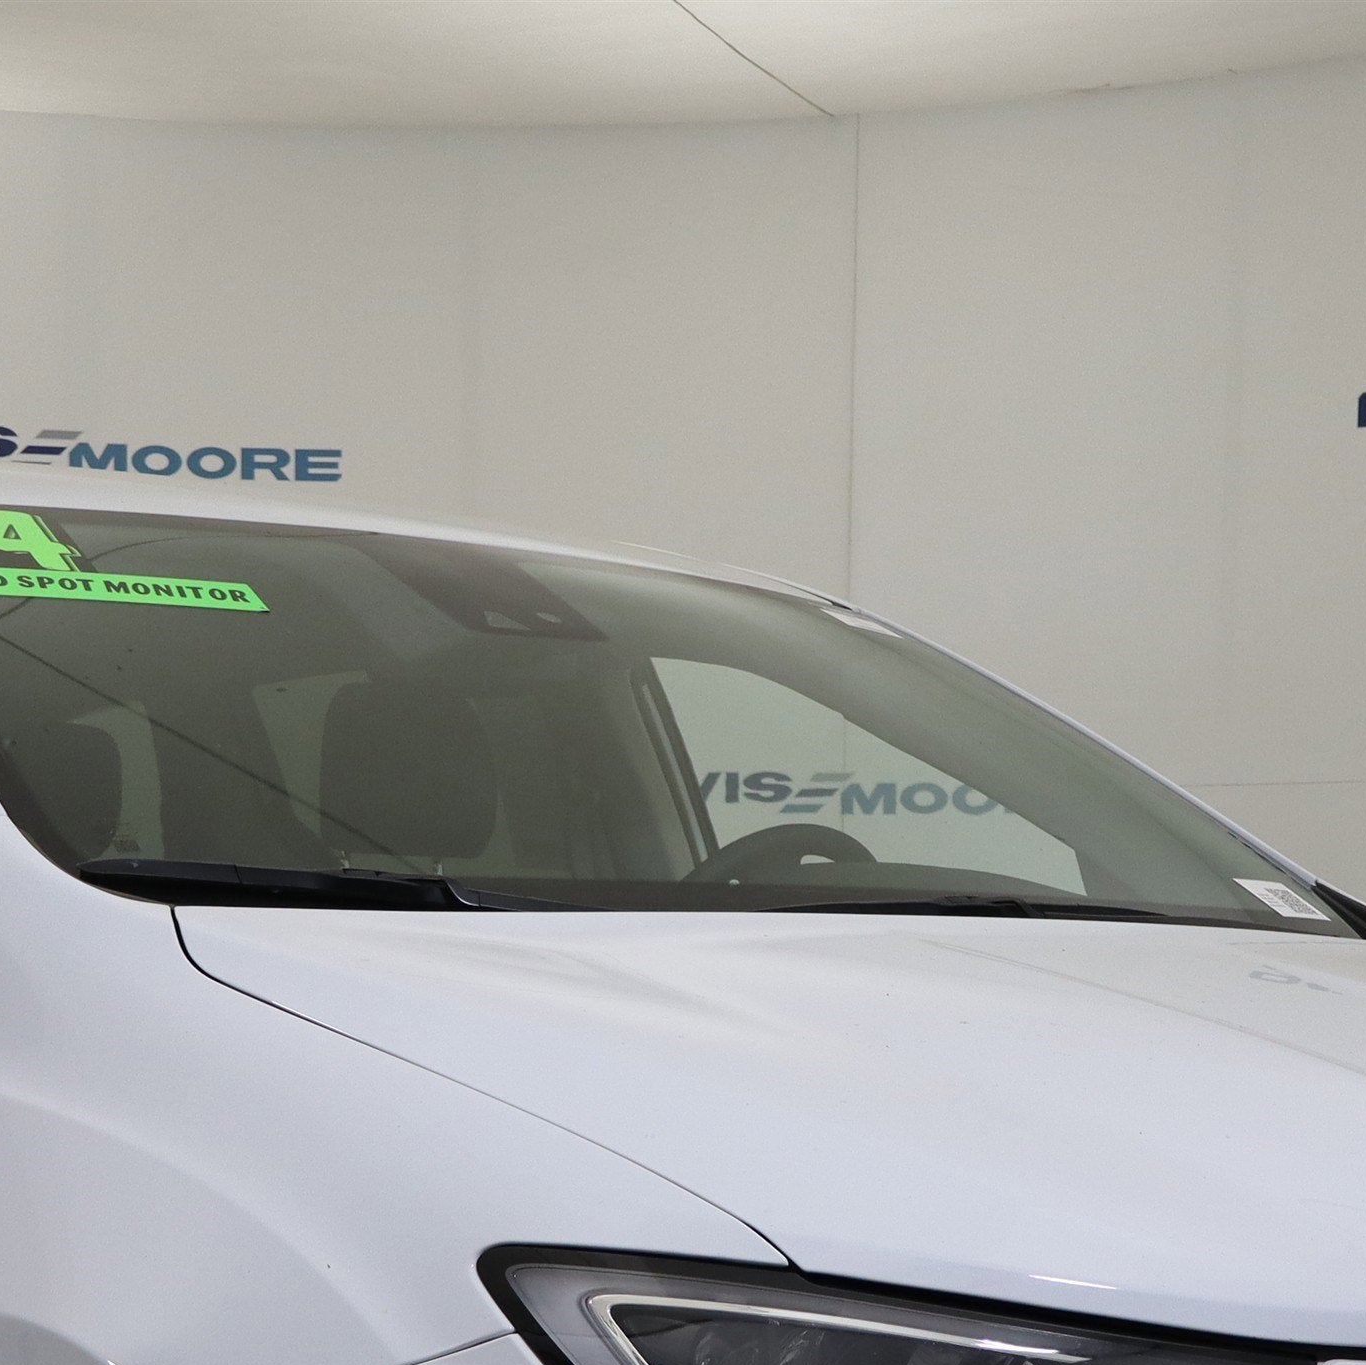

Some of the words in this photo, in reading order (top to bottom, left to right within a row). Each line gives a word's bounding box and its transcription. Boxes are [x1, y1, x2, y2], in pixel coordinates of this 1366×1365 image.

[68, 442, 344, 483] MOORE
[16, 574, 95, 592] SPOT
[102, 579, 252, 604] MONITOR
[840, 781, 1016, 816] MOO
